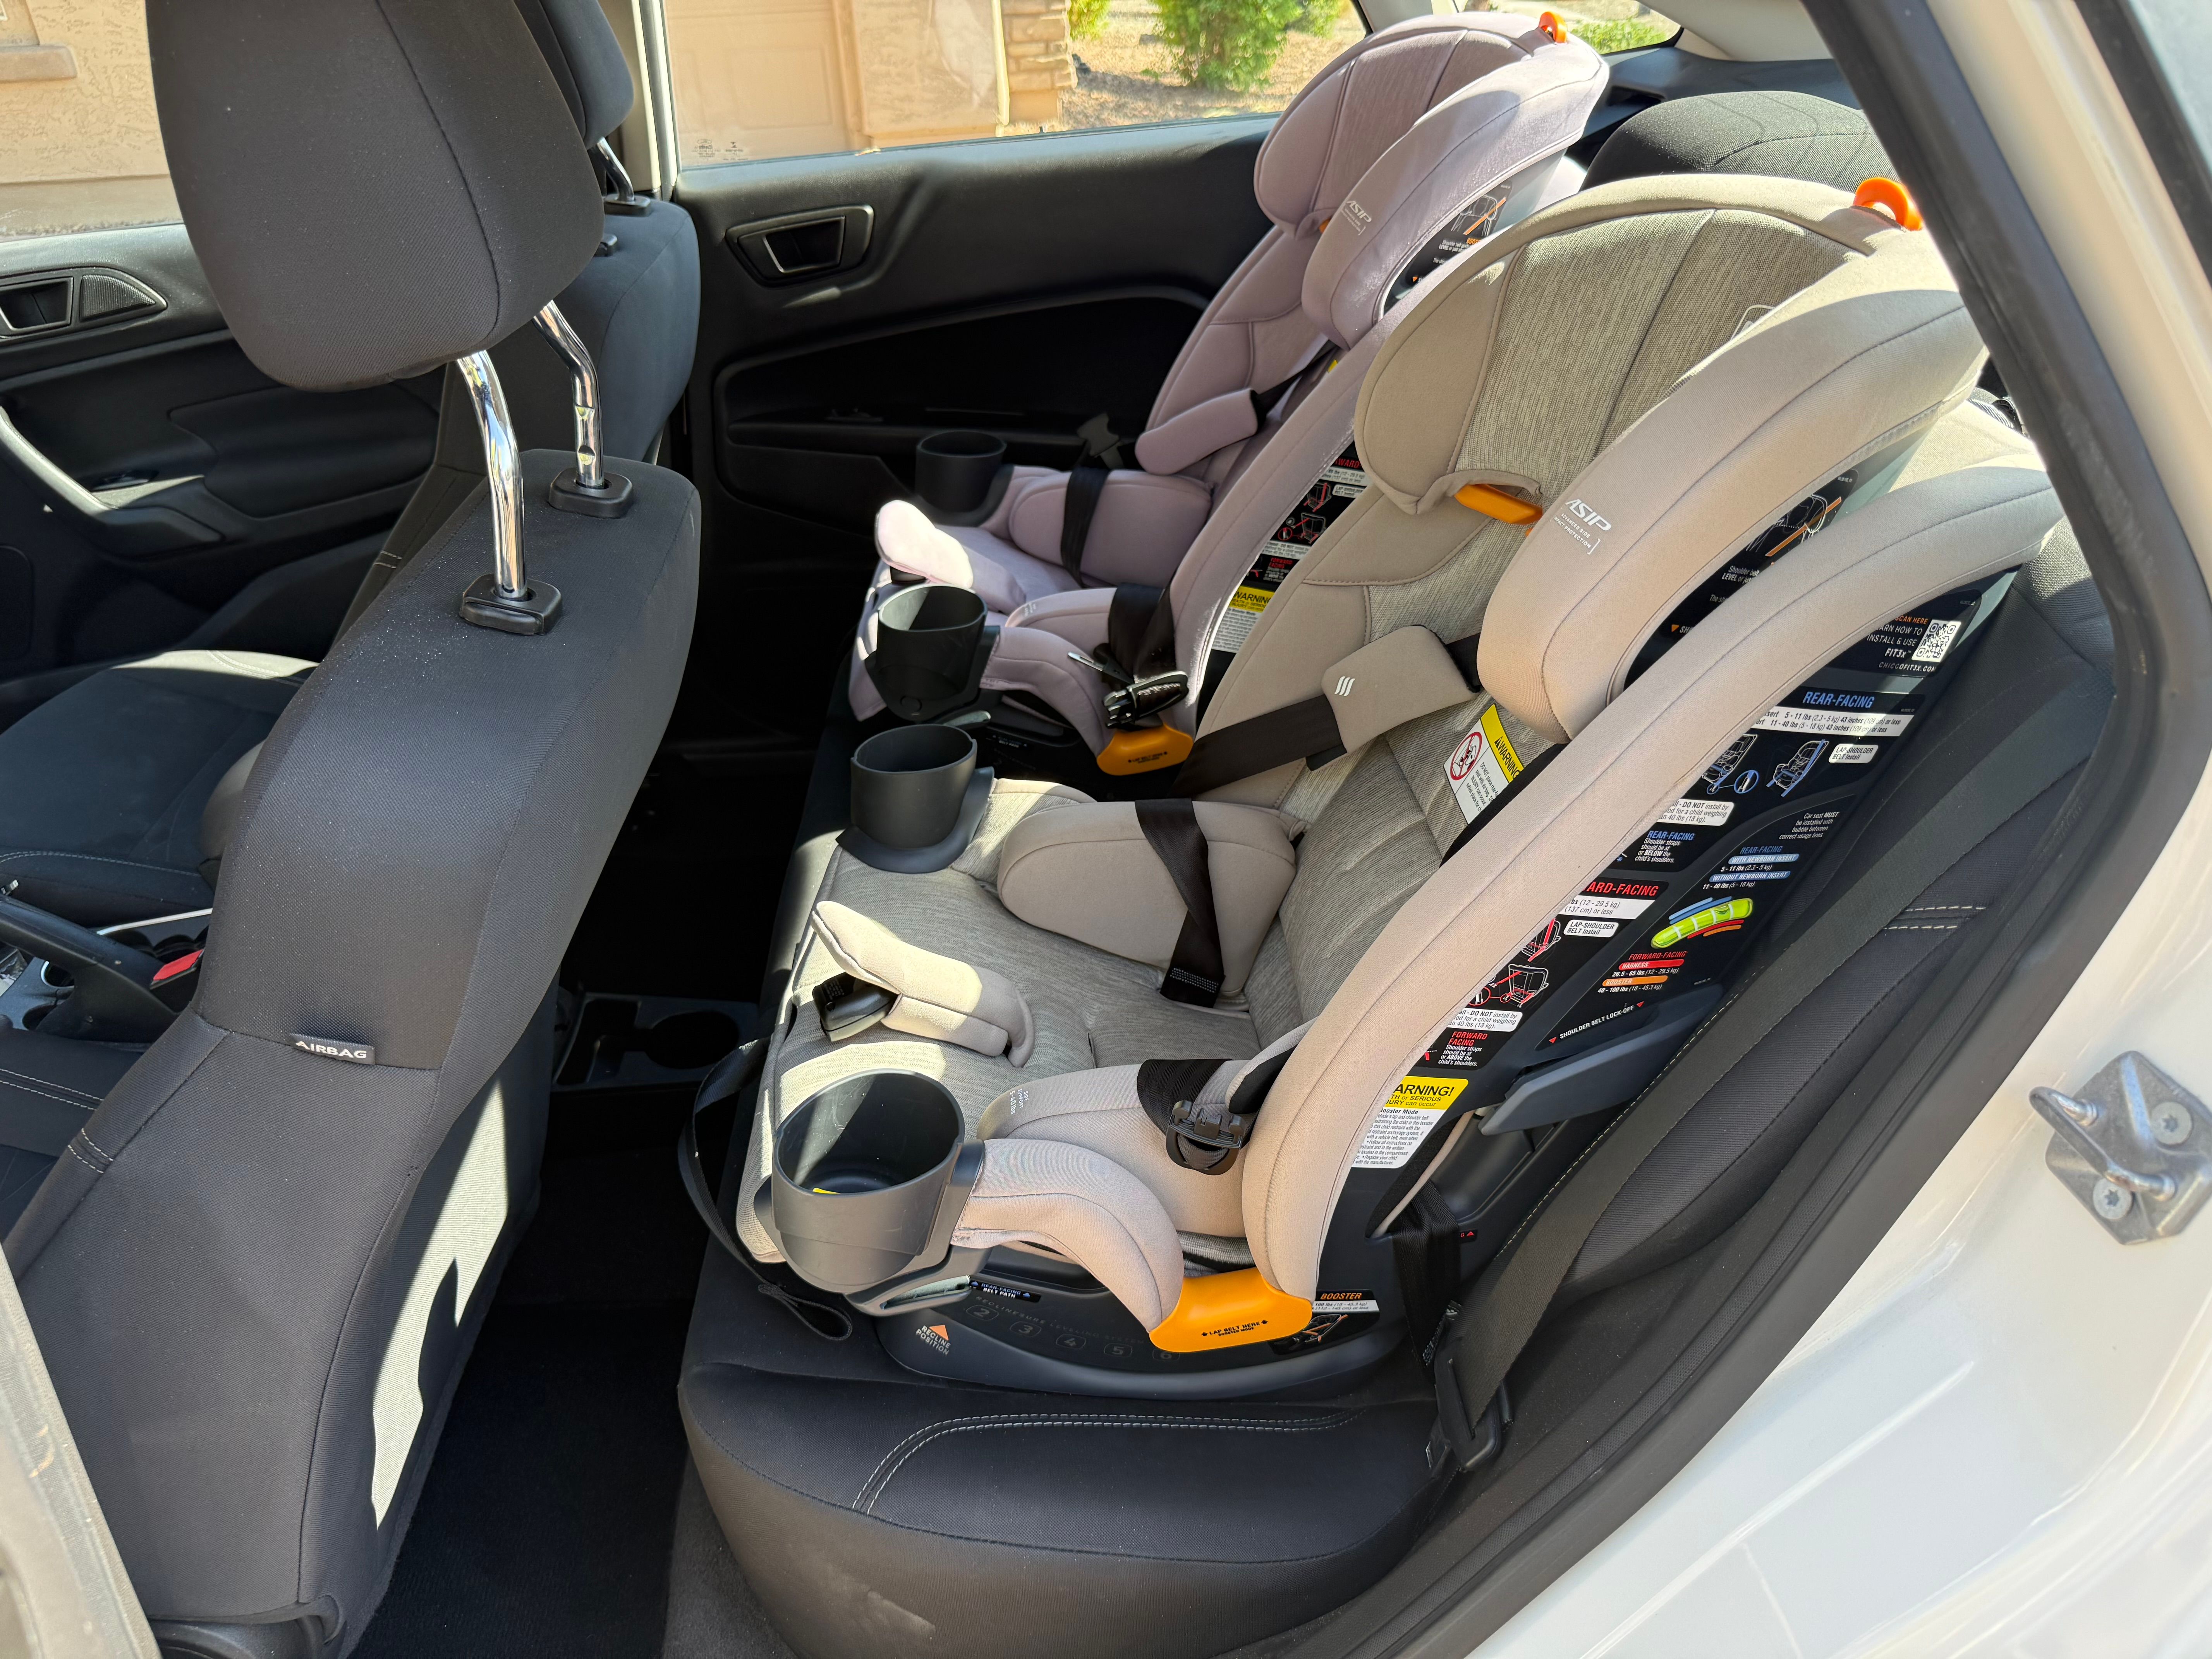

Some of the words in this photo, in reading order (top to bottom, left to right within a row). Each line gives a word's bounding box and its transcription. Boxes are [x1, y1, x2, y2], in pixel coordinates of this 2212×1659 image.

[1346, 201, 1372, 222] ASIP
[1565, 499, 1611, 531] ASIP
[1554, 516, 1565, 527] MPACT
[1564, 527, 1591, 548] PROTECTION
[1561, 513, 1580, 530] ADVANCED
[1580, 528, 1590, 539] SIDE
[1722, 573, 1736, 581] LEVEL
[1877, 624, 1894, 632] ARN
[1894, 625, 1913, 634] HOW
[1913, 627, 1922, 635] TO
[1867, 634, 1895, 644] INSTALL
[1903, 638, 1917, 646] USE
[1802, 691, 1875, 708] REAR-FACING
[1647, 830, 1696, 841] REAR-FACING
[1739, 845, 1783, 854] REAR-FACING
[1586, 881, 1660, 896] ARD-FACING
[1570, 921, 1615, 929] LAP-SHOULDER
[1628, 950, 1688, 960] FORWARD-FACING
[1559, 1022, 1591, 1039] SHOULDER
[1591, 1016, 1605, 1026] BELT
[1606, 1005, 1635, 1020] LOCK-OFF
[1448, 1038, 1475, 1046] FACING
[1452, 1031, 1488, 1041] FORWARD
[295, 1041, 367, 1058] AIRBAG
[1393, 1083, 1455, 1096] ARNING!
[981, 1283, 1021, 1296] REAR-FACING
[983, 1287, 998, 1295] BELT
[1000, 1291, 1016, 1299] PATH
[974, 1309, 990, 1317] 2
[1018, 1325, 1033, 1334] 3
[916, 1329, 949, 1355] POSITION
[922, 1325, 951, 1348] RECLINE
[1064, 1338, 1077, 1346] 4
[1113, 1346, 1124, 1355] 5
